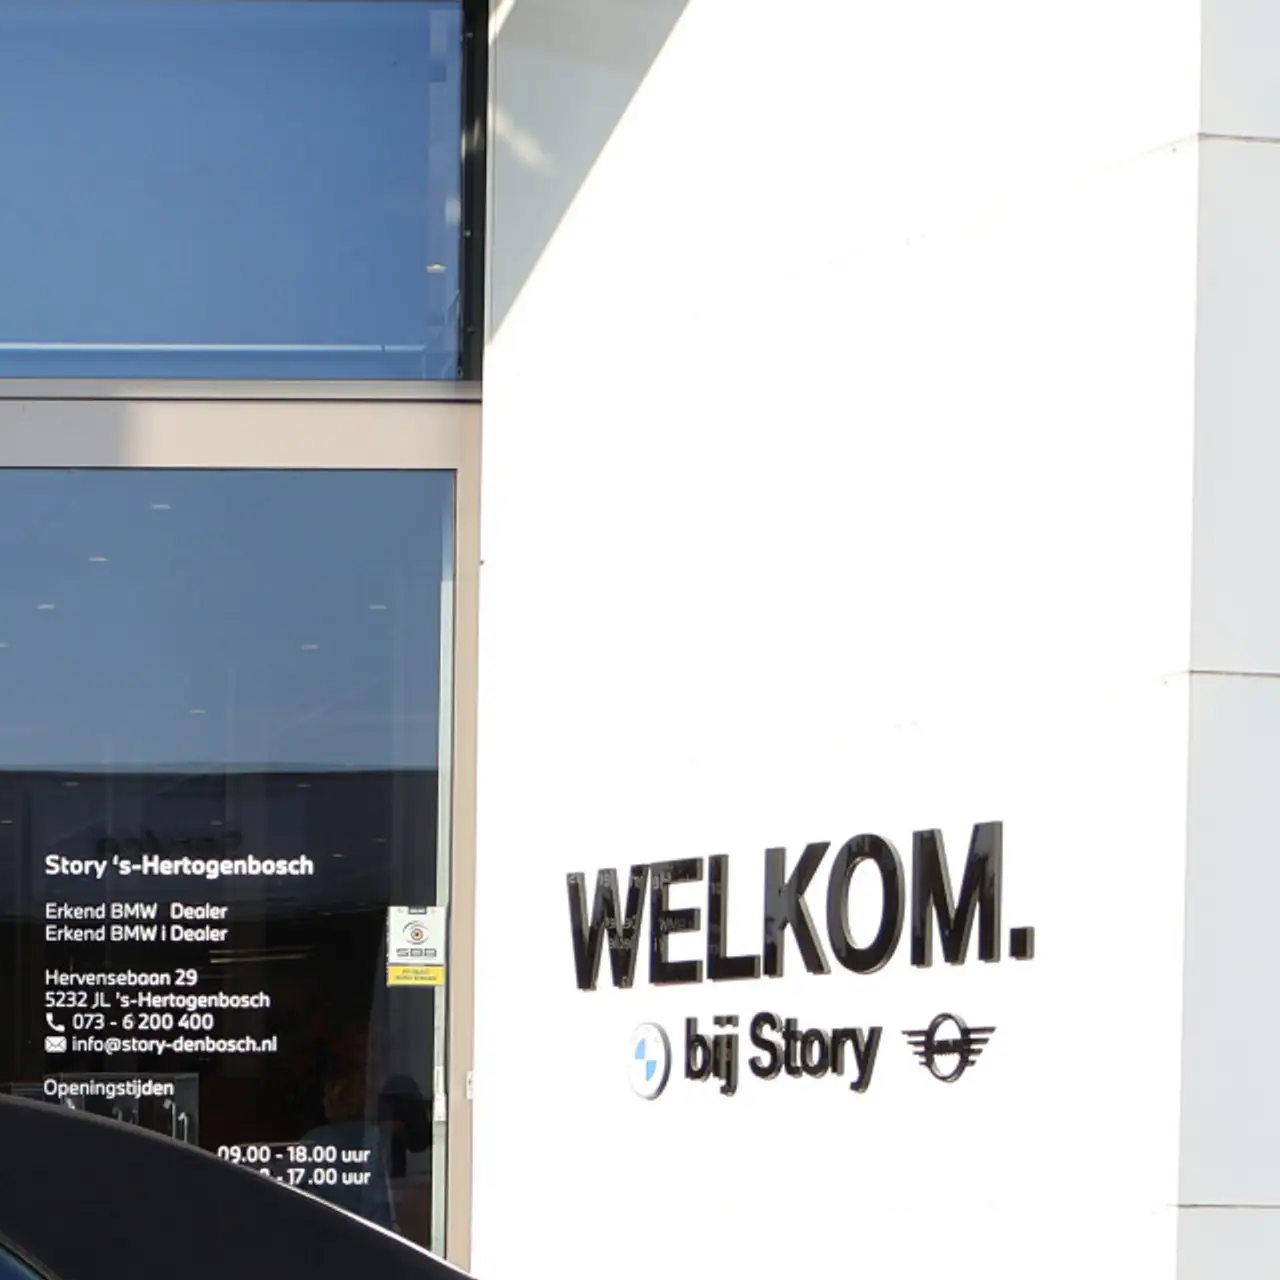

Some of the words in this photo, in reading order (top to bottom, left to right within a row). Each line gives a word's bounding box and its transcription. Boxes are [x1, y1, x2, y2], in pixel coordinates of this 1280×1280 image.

[45, 855, 106, 878] Story
[45, 903, 105, 920] Erkend
[111, 903, 157, 920] BMW
[171, 903, 228, 920] Dealer
[565, 820, 1035, 992] WELKOM.
[45, 926, 105, 941] Erkend
[111, 926, 155, 941] BMW
[161, 925, 166, 941] i
[171, 926, 228, 941] Dealer
[45, 970, 171, 986] Hervensebaan
[175, 970, 198, 986] 29
[45, 992, 87, 1008] 5232
[91, 992, 111, 1009] JL
[72, 1013, 105, 1030] 073
[123, 1013, 134, 1030] 6
[138, 1013, 174, 1030] 200
[178, 1013, 214, 1030] 400
[72, 1035, 277, 1054] info@story-denbosch.nl
[684, 1014, 739, 1096] bij
[748, 1010, 883, 1093] Story
[44, 1079, 174, 1099] Openingstijden
[287, 1145, 337, 1163] 18.00
[341, 1148, 371, 1163] uur
[341, 1171, 371, 1186] uur
